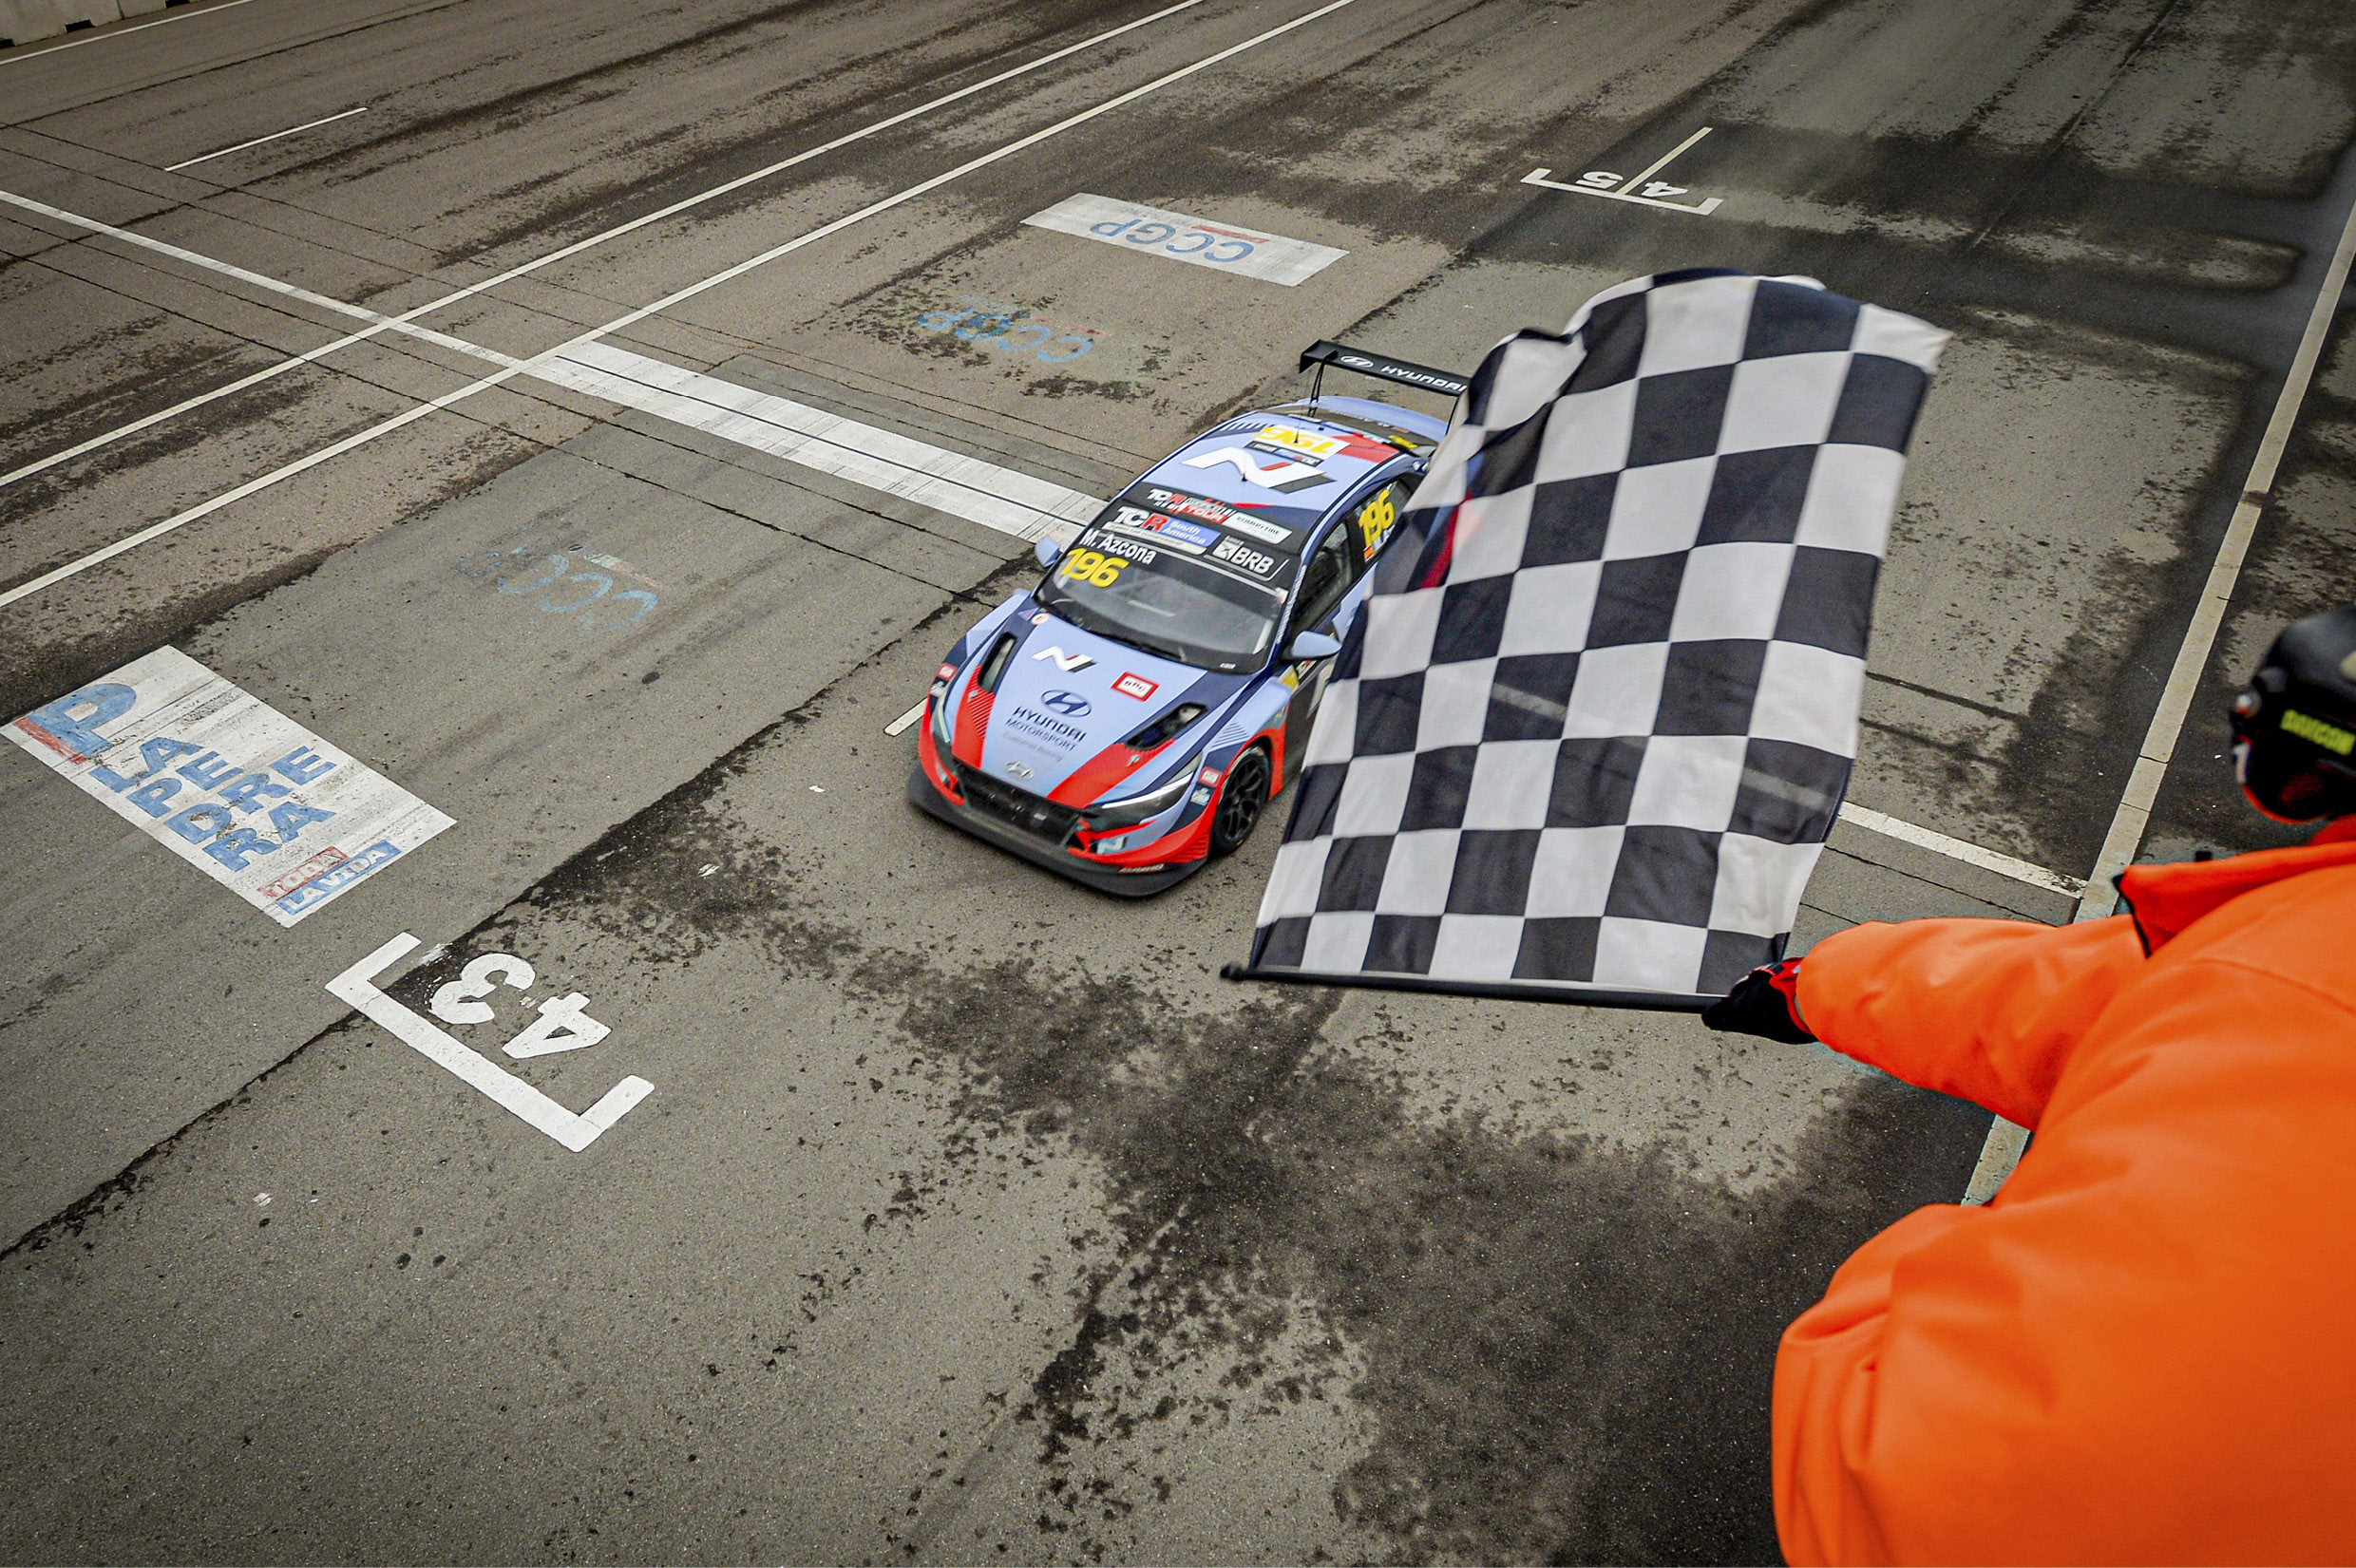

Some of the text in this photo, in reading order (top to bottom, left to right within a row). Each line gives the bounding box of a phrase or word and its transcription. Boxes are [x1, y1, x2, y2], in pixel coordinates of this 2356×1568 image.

[1091, 219, 1254, 263] CCGP
[1380, 365, 1468, 392] HYUNDAI
[1113, 505, 1171, 532] TCR
[1358, 488, 1395, 548] 196
[1061, 547, 1130, 588] 196
[1095, 531, 1157, 565] Azcona
[1230, 546, 1274, 575] BRB
[1005, 718, 1078, 752] MOTORSPORT
[1012, 706, 1087, 743] HYUNDAI
[89, 736, 202, 794] LA
[126, 750, 244, 819] PE
[164, 746, 338, 844] DRE
[203, 799, 337, 873] RA
[428, 952, 613, 1059] 43
